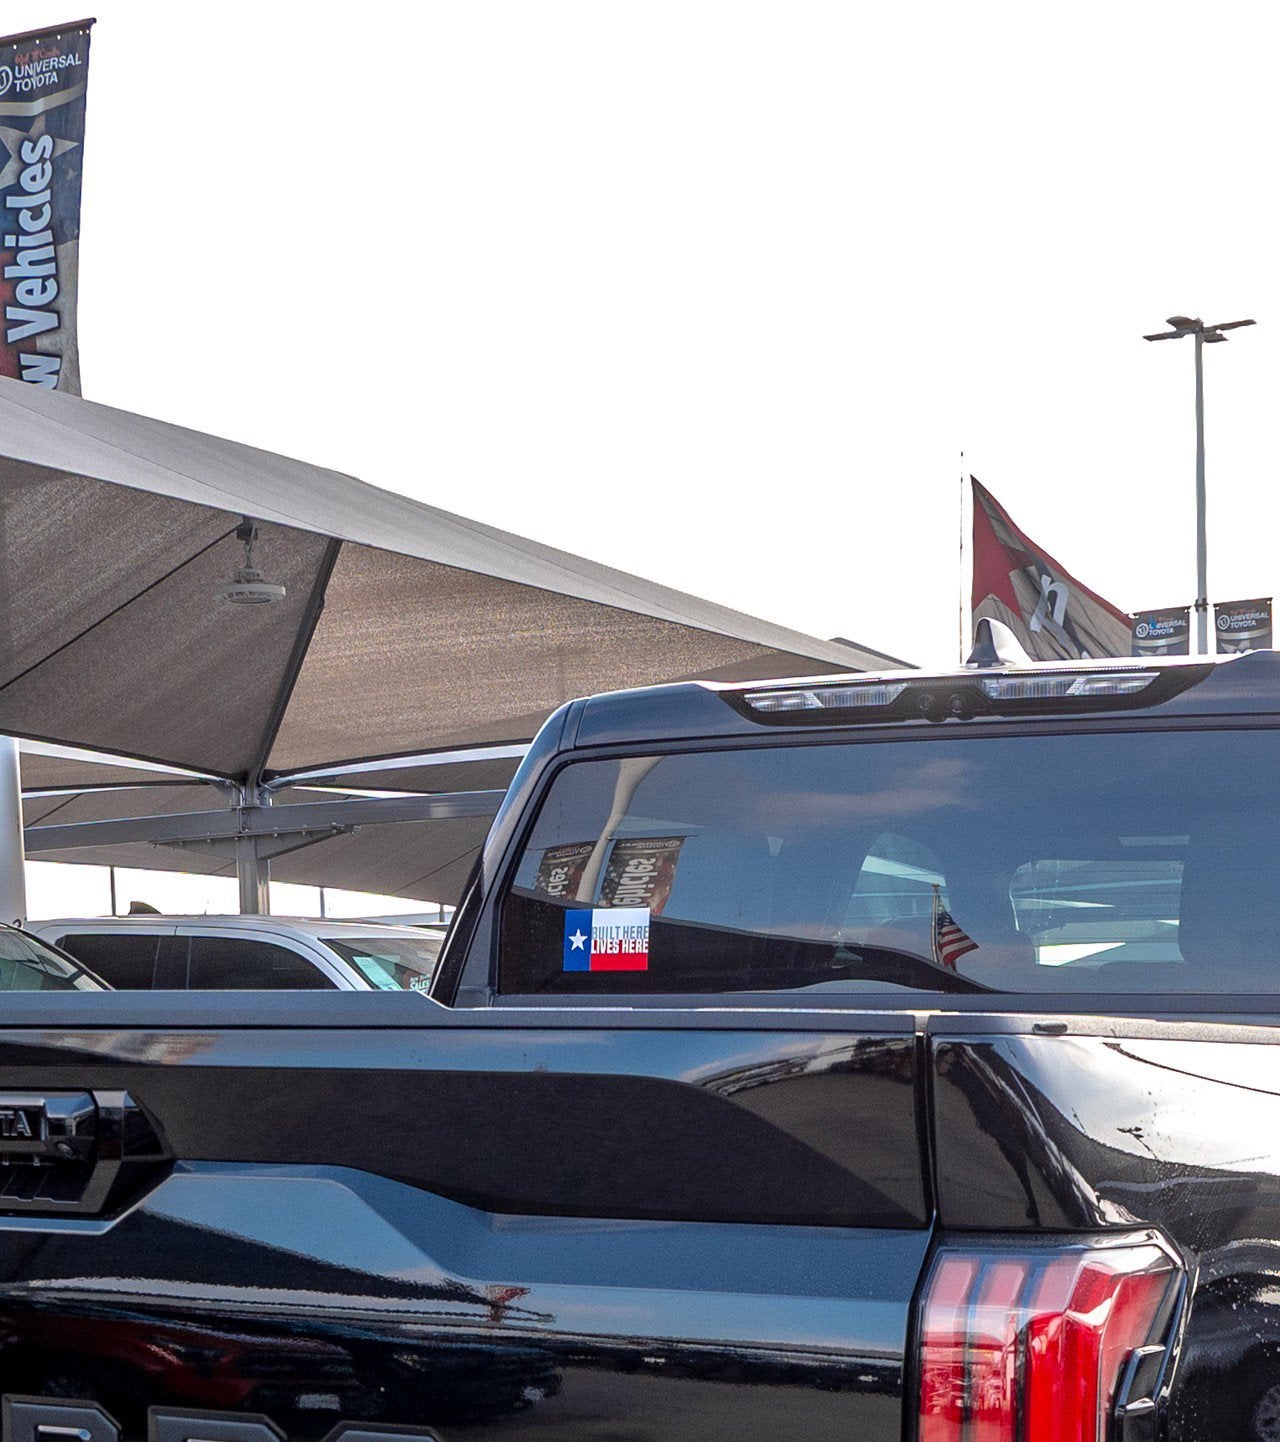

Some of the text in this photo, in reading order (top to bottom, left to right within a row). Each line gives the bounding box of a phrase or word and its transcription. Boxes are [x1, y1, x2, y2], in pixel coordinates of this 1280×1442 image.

[14, 53, 82, 78] UNIVERSAL
[13, 71, 59, 92] TOYOTA
[3, 132, 61, 345] Vehicles
[1148, 628, 1175, 636] TOYOTA
[1230, 620, 1257, 629] TOYOTA
[622, 926, 648, 939] HERE
[590, 939, 649, 954] LIVES HERE
